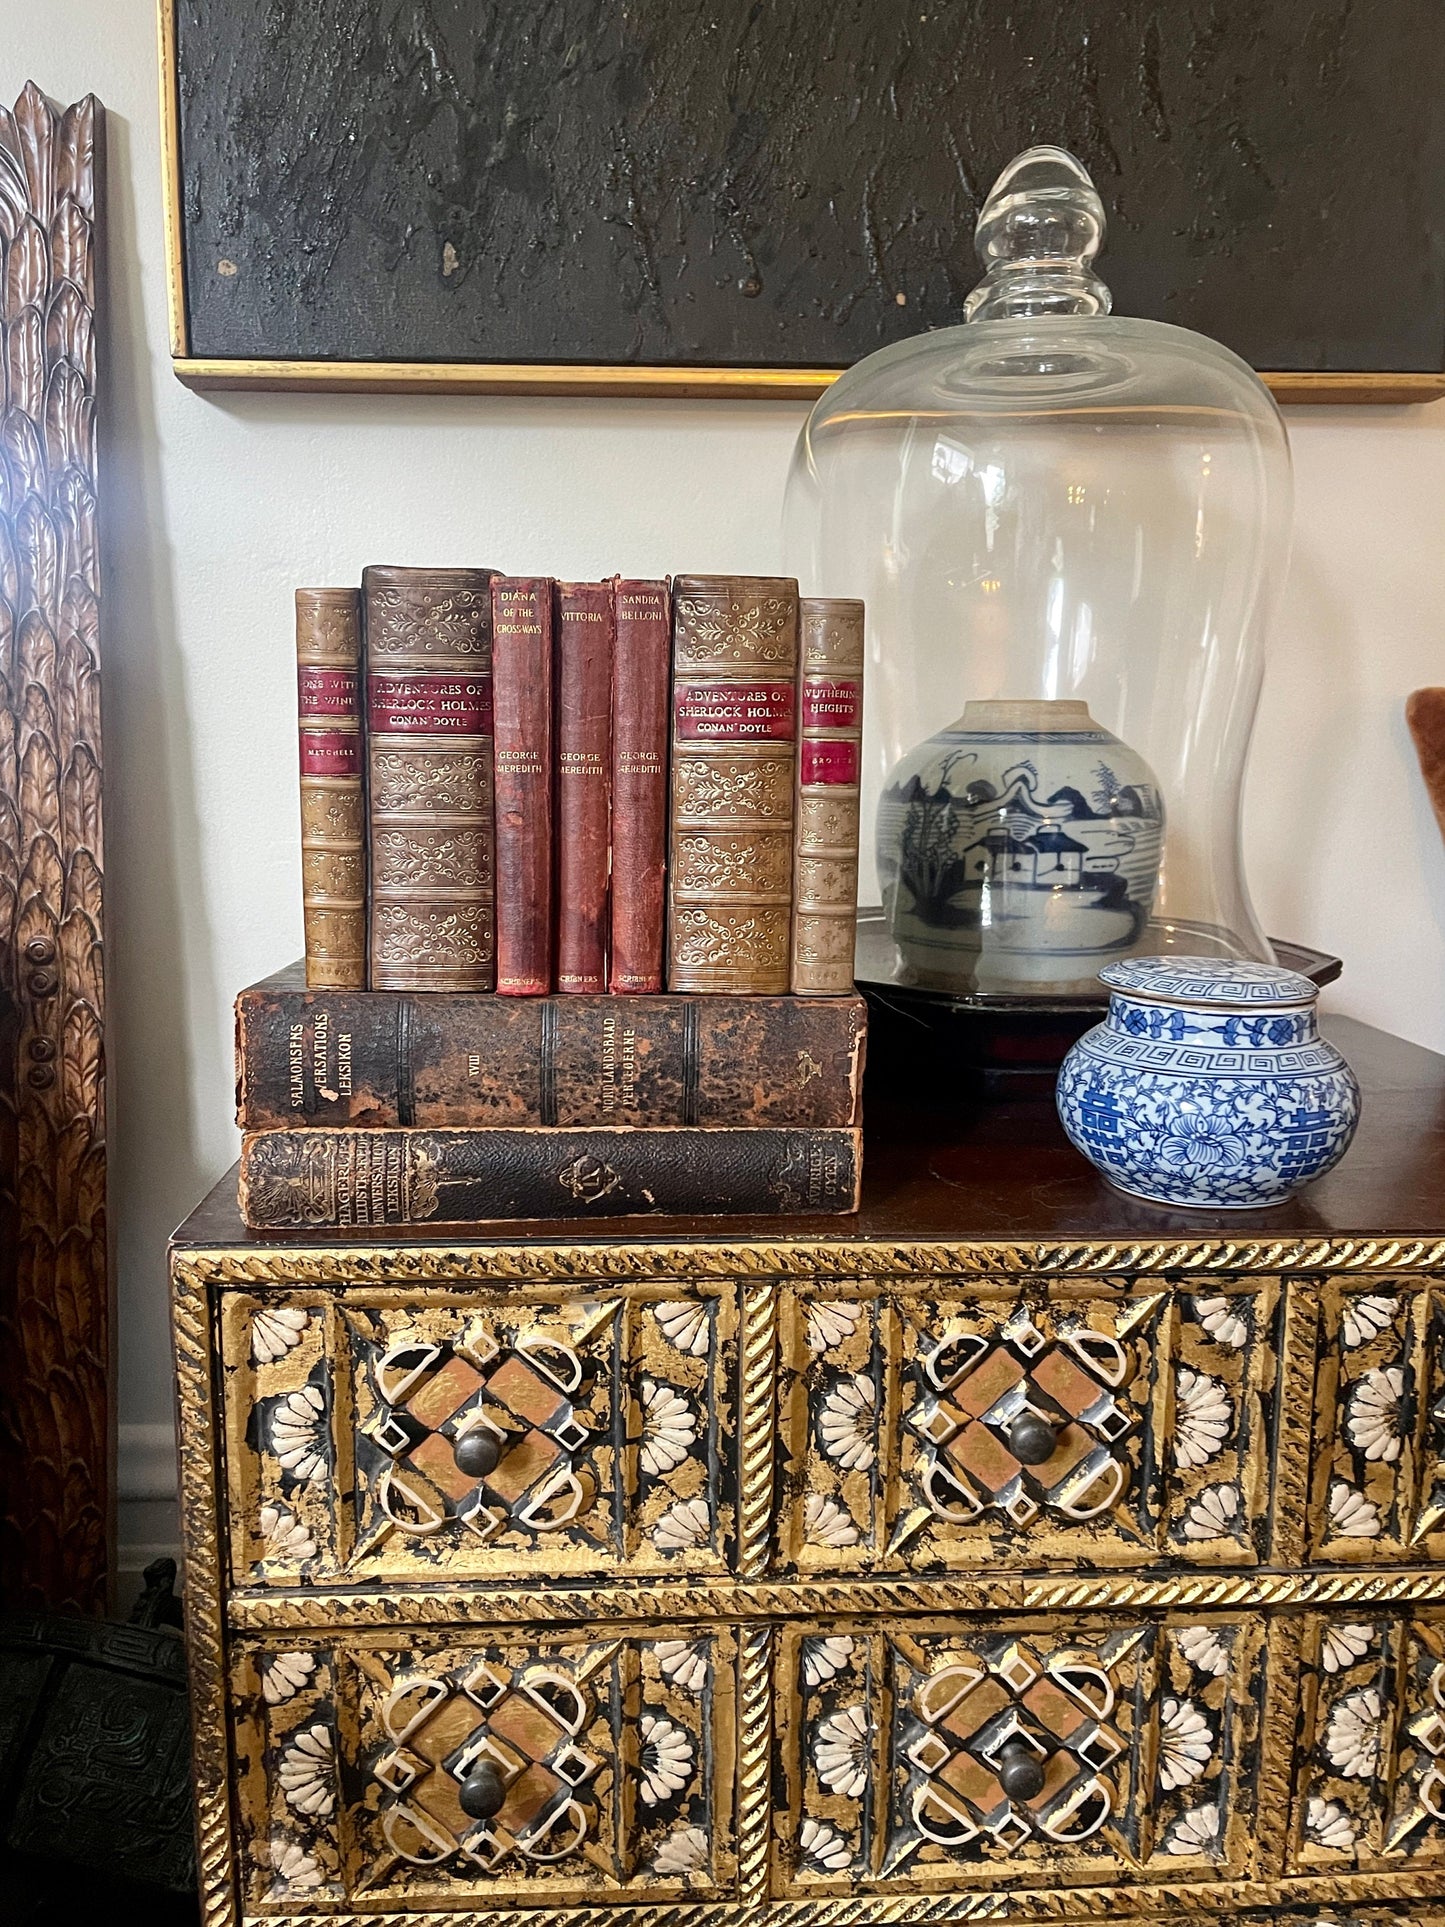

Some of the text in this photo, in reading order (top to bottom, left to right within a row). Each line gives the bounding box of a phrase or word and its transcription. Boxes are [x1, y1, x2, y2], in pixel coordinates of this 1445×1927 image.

[501, 592, 536, 601] DIANA
[622, 596, 660, 604] SANDRA
[504, 608, 534, 618] OF THE
[560, 612, 602, 622] VITTORIA
[622, 611, 662, 620] BELLONI
[301, 680, 324, 688] ONE
[466, 685, 484, 695] OF
[804, 688, 859, 698] WUTHERIN
[679, 706, 742, 718] SHERLOCK
[810, 704, 853, 714] HEIGHTS
[390, 716, 468, 726] CONAN DOYLE
[697, 722, 772, 733] CONAN DOYLE
[500, 751, 538, 760] GEORGE
[560, 753, 601, 762] GEORGE
[338, 1034, 352, 1096] LEKSIKON
[602, 1018, 616, 1112] NORDLANDSBAAD
[386, 1146, 400, 1212] LEKSIKON
